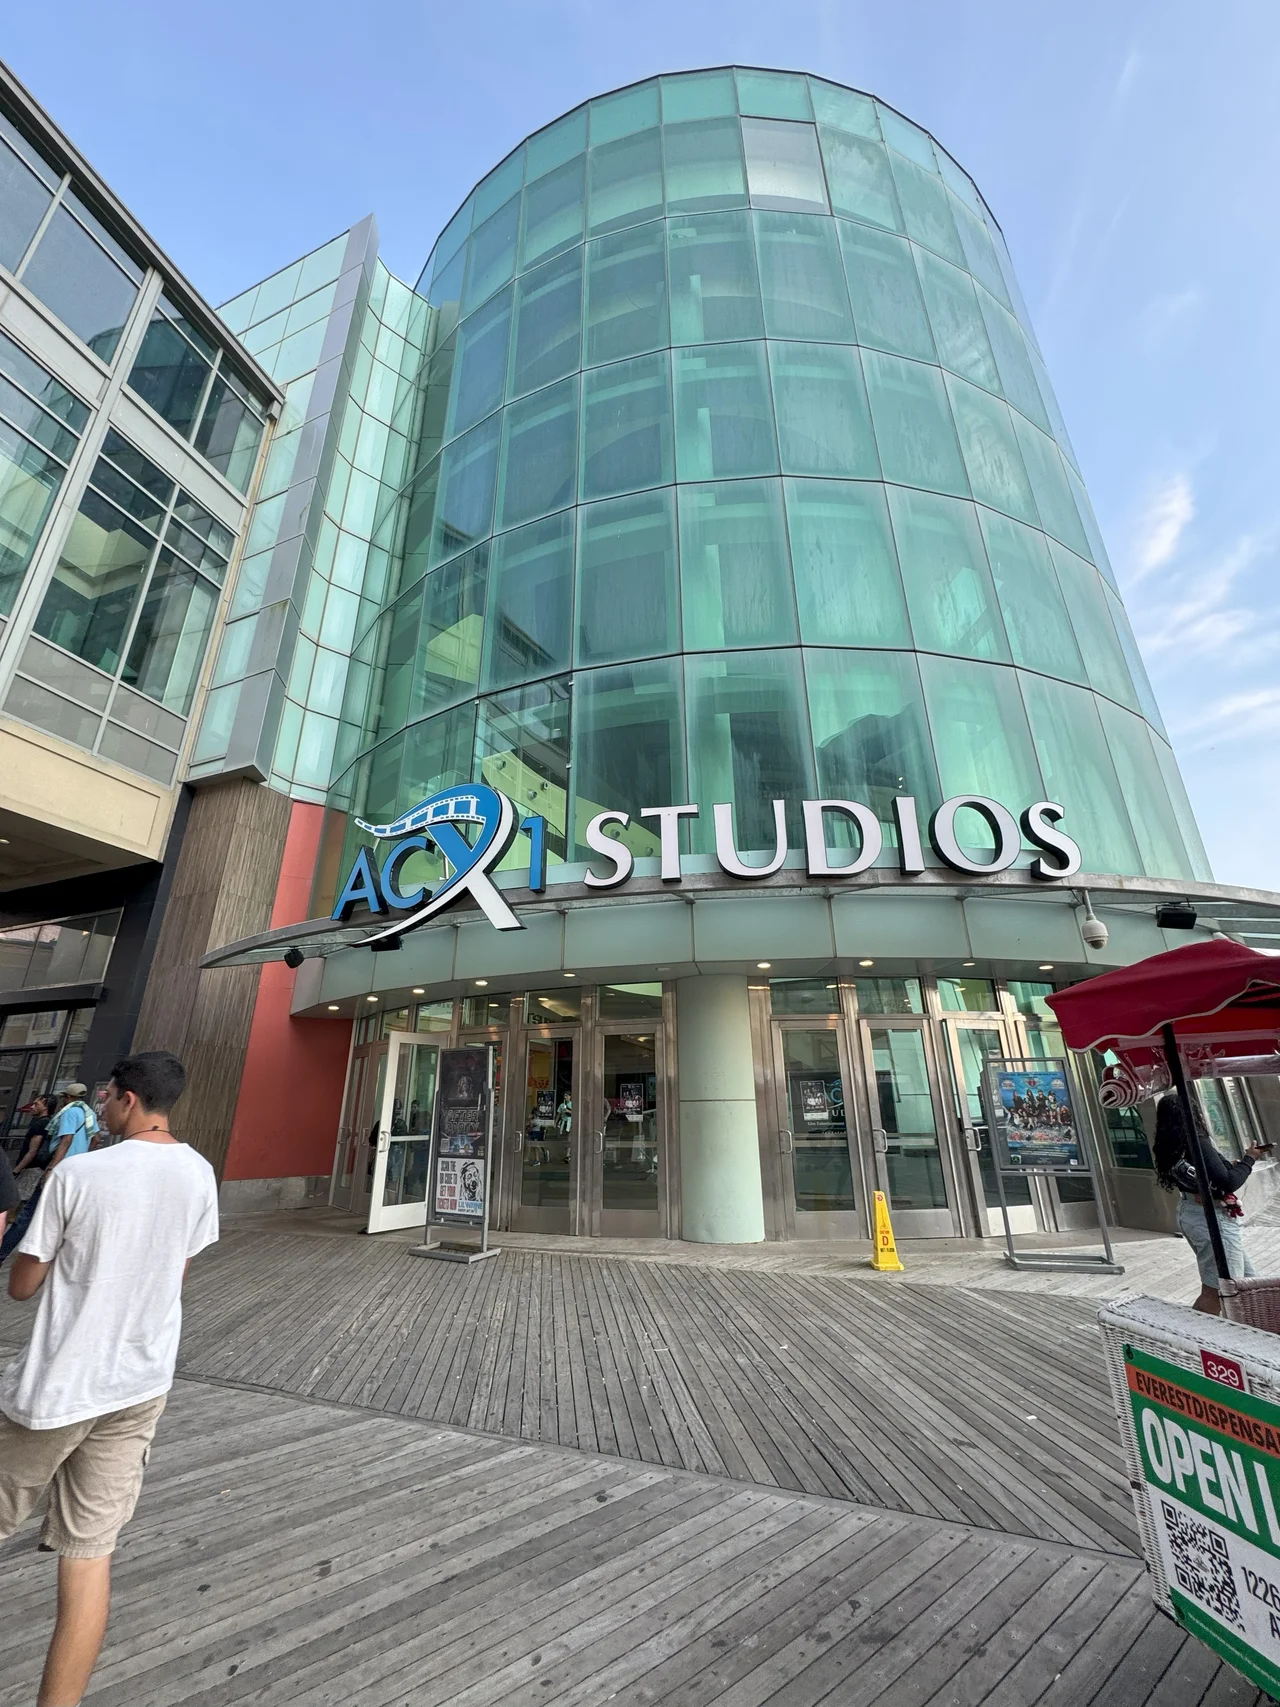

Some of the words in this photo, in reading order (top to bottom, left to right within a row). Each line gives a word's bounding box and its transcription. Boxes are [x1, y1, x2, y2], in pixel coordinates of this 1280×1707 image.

[583, 794, 1082, 889] STUDIOS
[446, 1109, 480, 1122] AFTER
[1136, 1371, 1280, 1455] EVERESTDISPENSA
[1207, 1360, 1240, 1387] 329
[1142, 1406, 1260, 1535] OPEN
